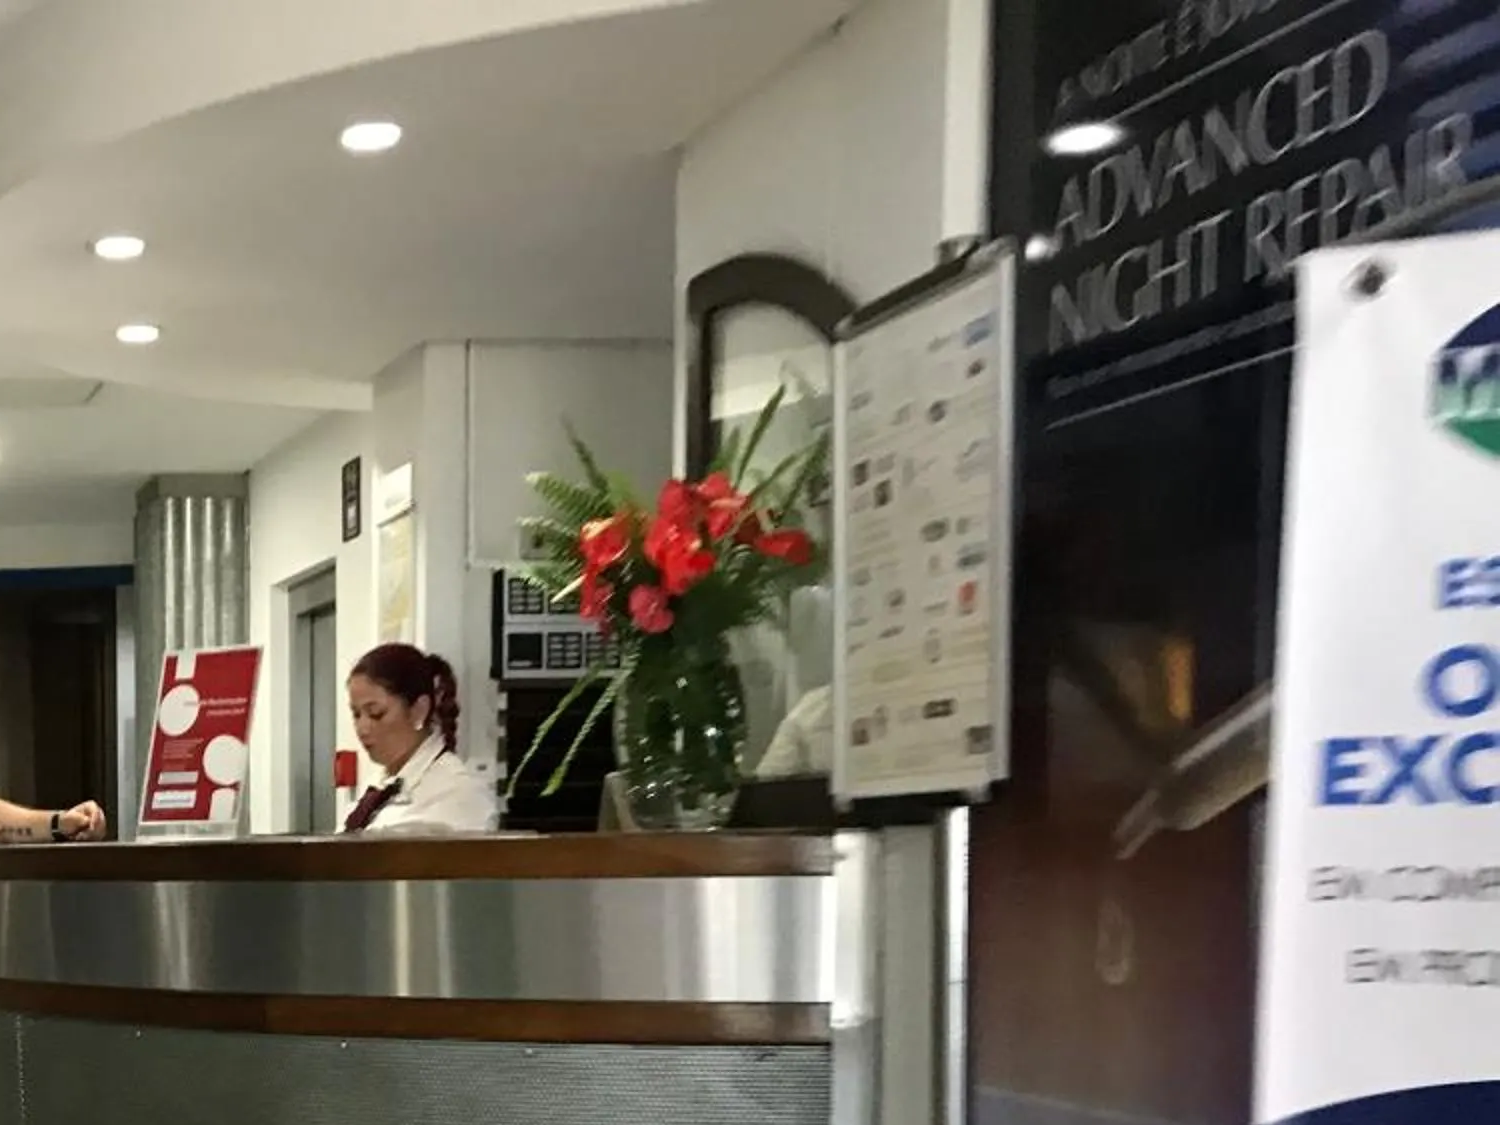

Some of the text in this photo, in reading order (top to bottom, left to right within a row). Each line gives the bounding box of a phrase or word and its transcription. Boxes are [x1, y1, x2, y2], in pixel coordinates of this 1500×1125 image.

[1047, 209, 1234, 356] NIGHT
[1243, 112, 1474, 285] REPAIR
[1049, 28, 1390, 252] ADVANCED
